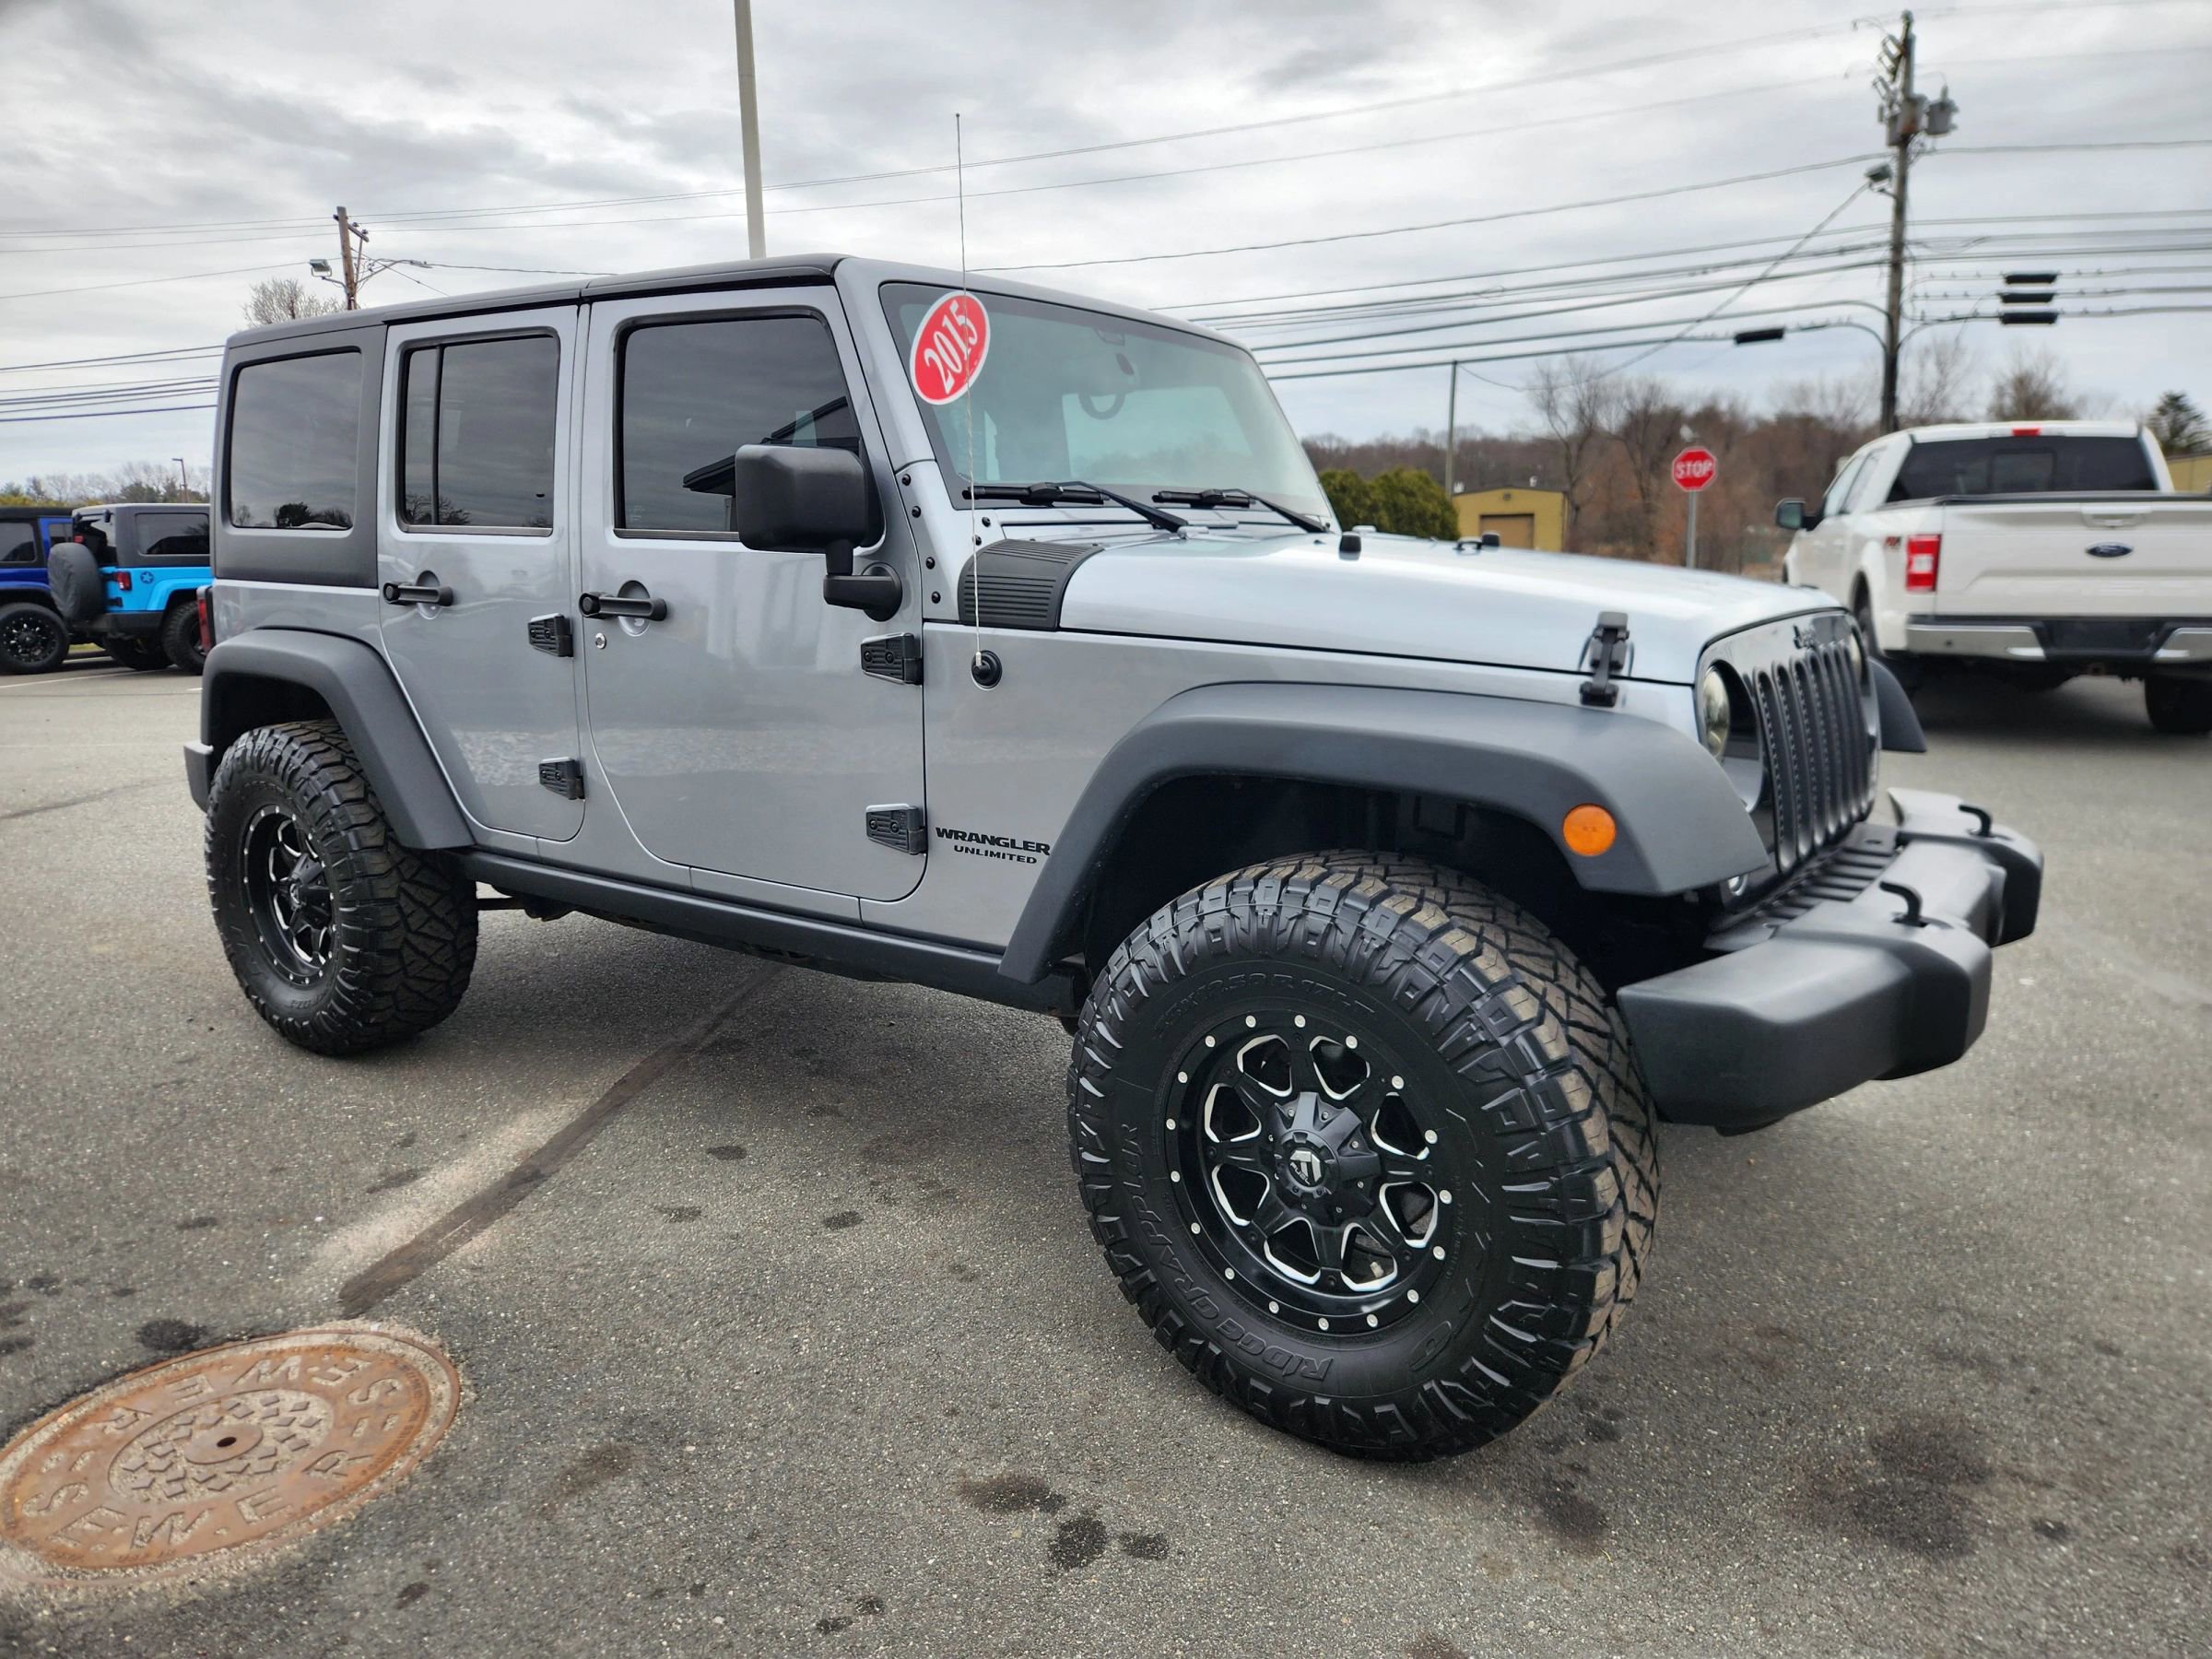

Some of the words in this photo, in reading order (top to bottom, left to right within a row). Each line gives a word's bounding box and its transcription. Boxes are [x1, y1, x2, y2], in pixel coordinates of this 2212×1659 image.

[924, 299, 978, 395] 2015
[1676, 459, 1713, 479] STOP
[935, 827, 1051, 856] WRANGLER
[954, 844, 1038, 865] UNLIMITED
[1288, 1160, 1311, 1186] FUEL
[1216, 1317, 1335, 1381] RIDGE
